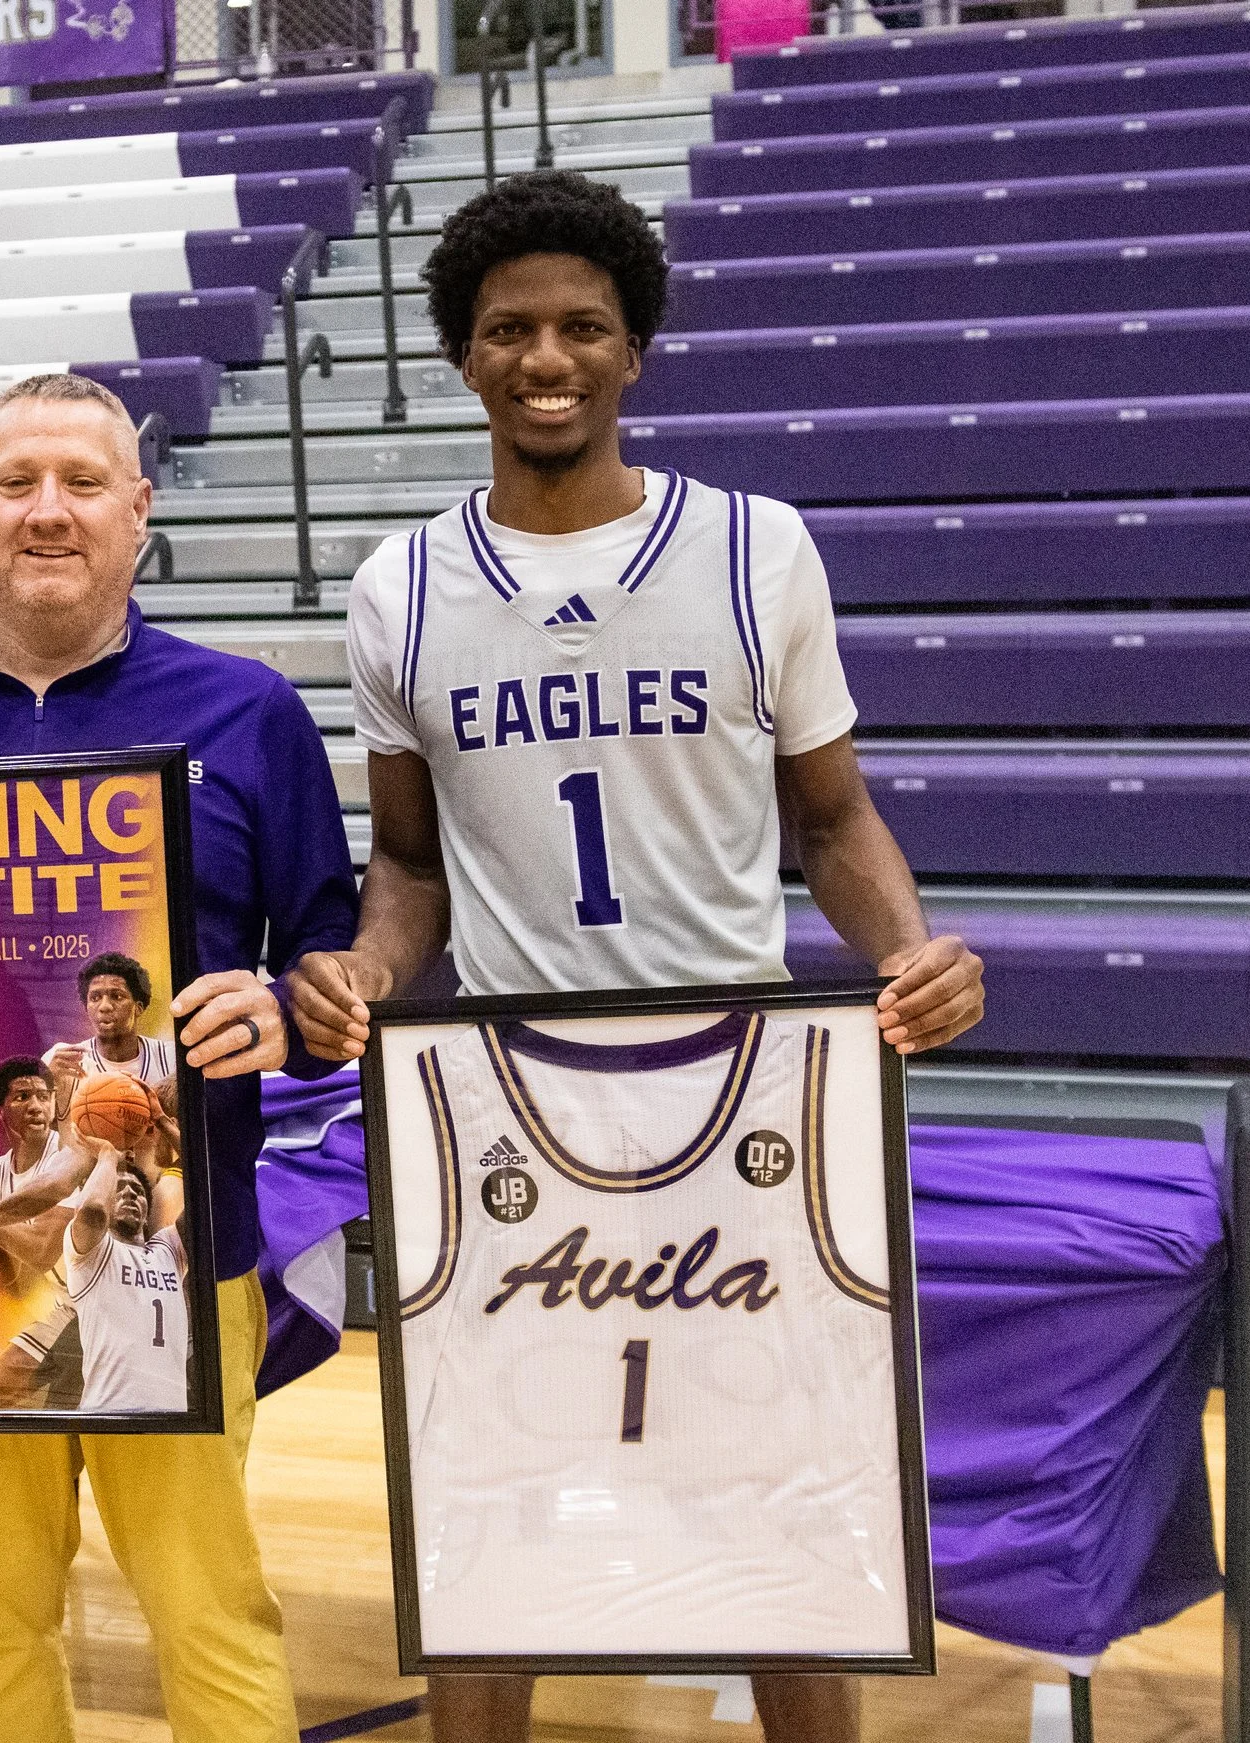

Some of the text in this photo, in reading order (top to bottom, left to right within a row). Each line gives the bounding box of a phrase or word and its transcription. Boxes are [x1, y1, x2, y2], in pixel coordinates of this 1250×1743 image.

[447, 668, 709, 753] EAGLES
[553, 766, 628, 932] 1
[42, 934, 91, 960] 2025
[479, 1154, 529, 1167] adidas
[746, 1140, 786, 1170] DC
[750, 1168, 774, 1183] #12
[490, 1177, 528, 1206] JB
[500, 1205, 523, 1218] #21
[483, 1224, 781, 1315] Avila
[151, 1298, 165, 1348] 1
[619, 1337, 651, 1445] 1
